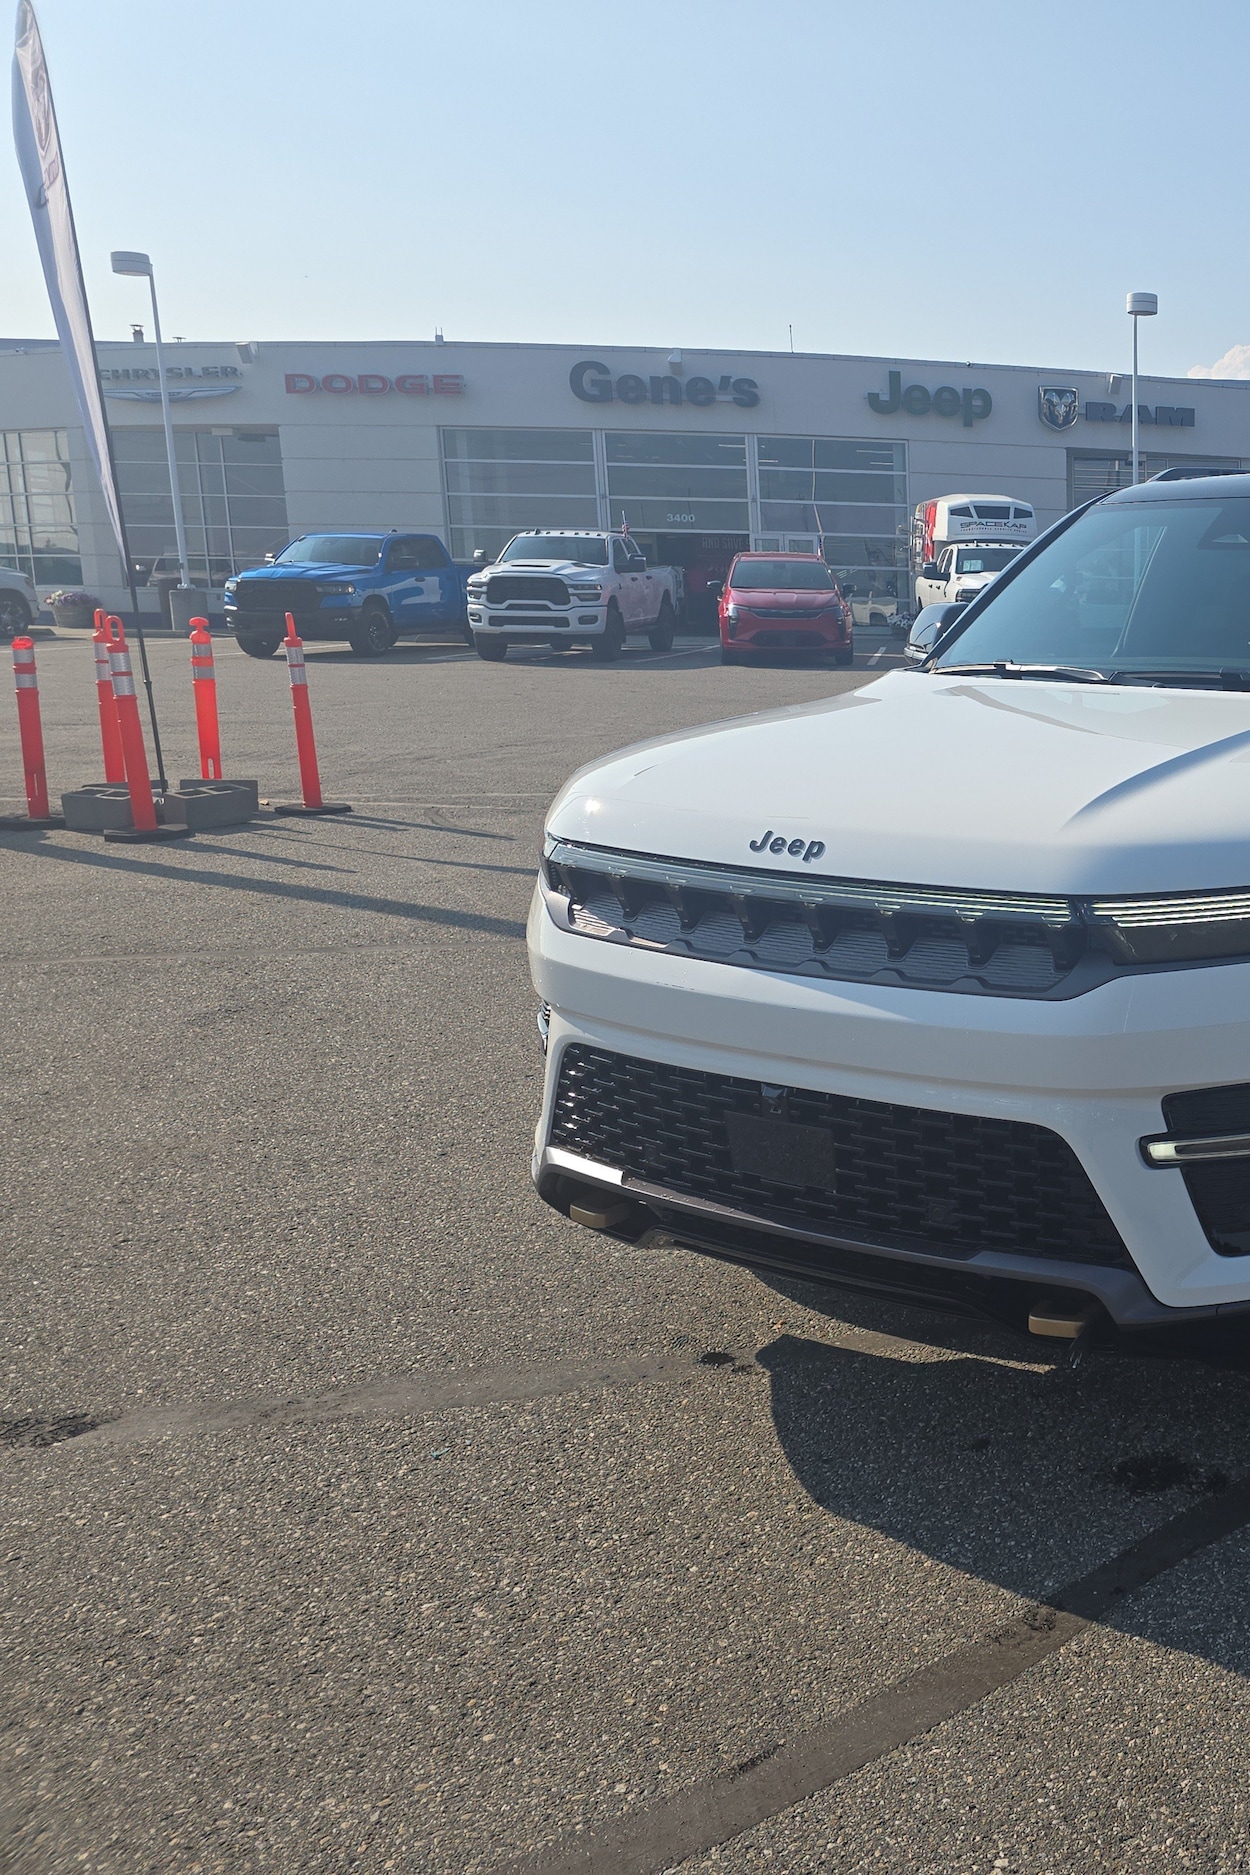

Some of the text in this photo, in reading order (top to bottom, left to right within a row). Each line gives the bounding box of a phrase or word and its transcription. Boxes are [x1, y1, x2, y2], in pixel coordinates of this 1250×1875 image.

[284, 373, 464, 396] DODGE
[569, 360, 761, 408] Gene's
[867, 371, 993, 427] Jeep
[1085, 401, 1195, 427] RAM
[666, 513, 696, 522] 3400
[749, 830, 826, 862] Jeep
